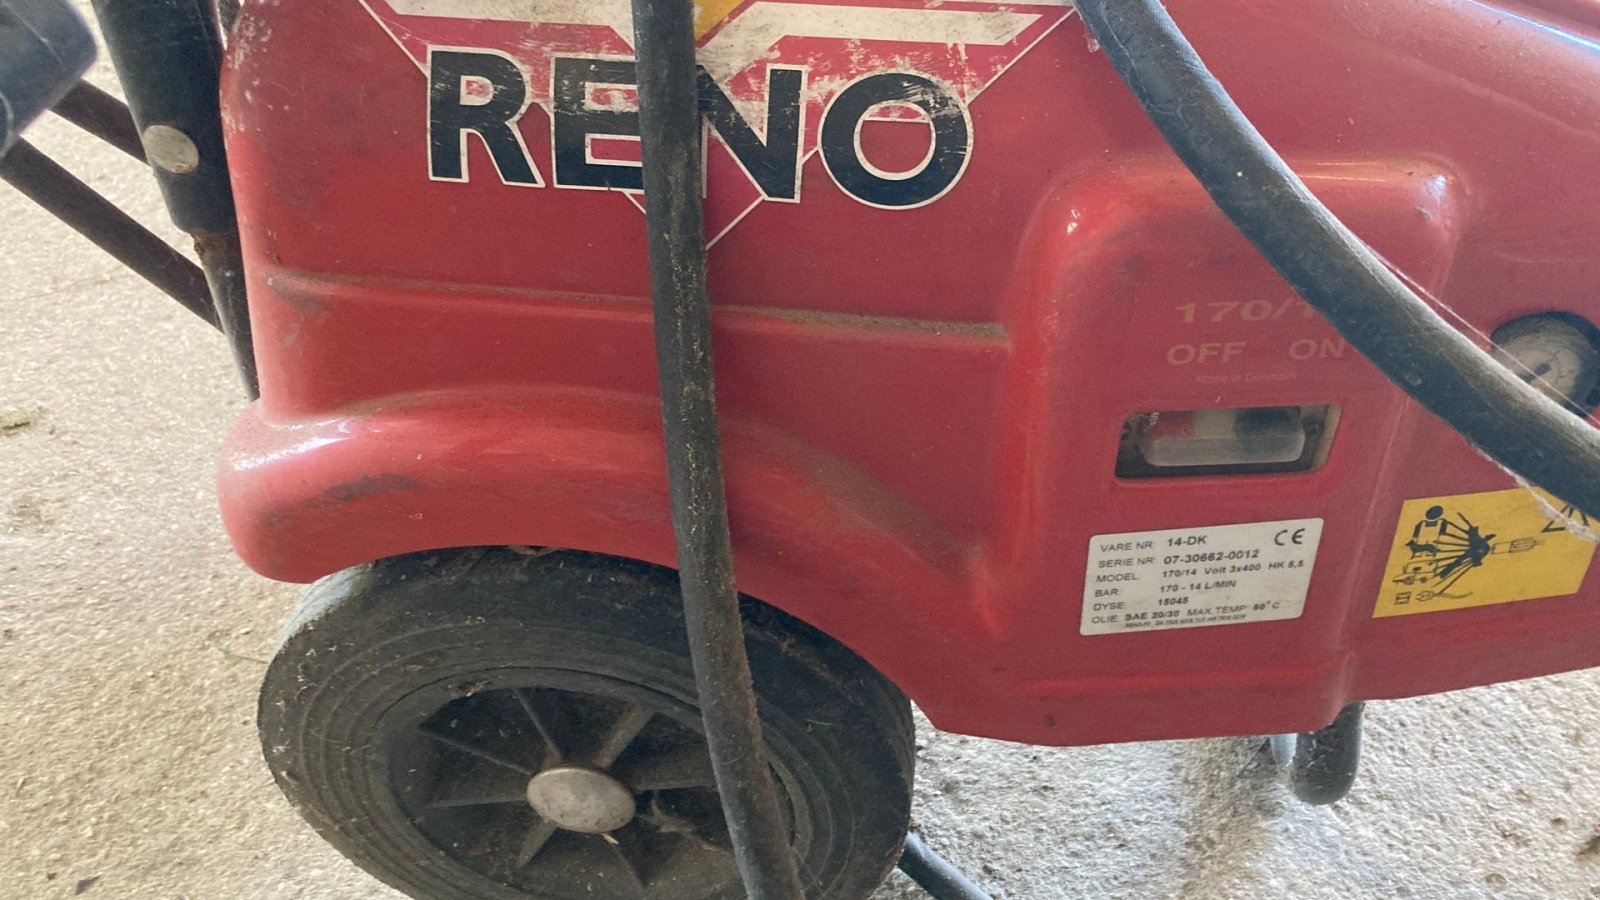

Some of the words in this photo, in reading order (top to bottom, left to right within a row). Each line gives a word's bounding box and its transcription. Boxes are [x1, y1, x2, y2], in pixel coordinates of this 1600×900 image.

[427, 46, 974, 209] RENO
[1175, 297, 1313, 323] 170/1
[1167, 342, 1246, 365] OFF
[1287, 338, 1346, 360] ON
[1100, 542, 1132, 552] VARE
[1167, 535, 1207, 547] 14-DK
[1274, 528, 1306, 546] CE
[1098, 558, 1134, 568] SERIE
[1163, 549, 1260, 565] 07-30662-0012
[1162, 569, 1197, 578] 170/14
[1204, 567, 1226, 575] Volt
[1229, 563, 1261, 573] 3x400
[1268, 562, 1284, 570] HK
[1160, 584, 1179, 593] 170
[1190, 583, 1202, 591] 14
[1204, 580, 1237, 590] L/MIN
[1158, 597, 1189, 606] 15045
[1124, 612, 1148, 621] SAE
[1151, 610, 1180, 619] 20/30
